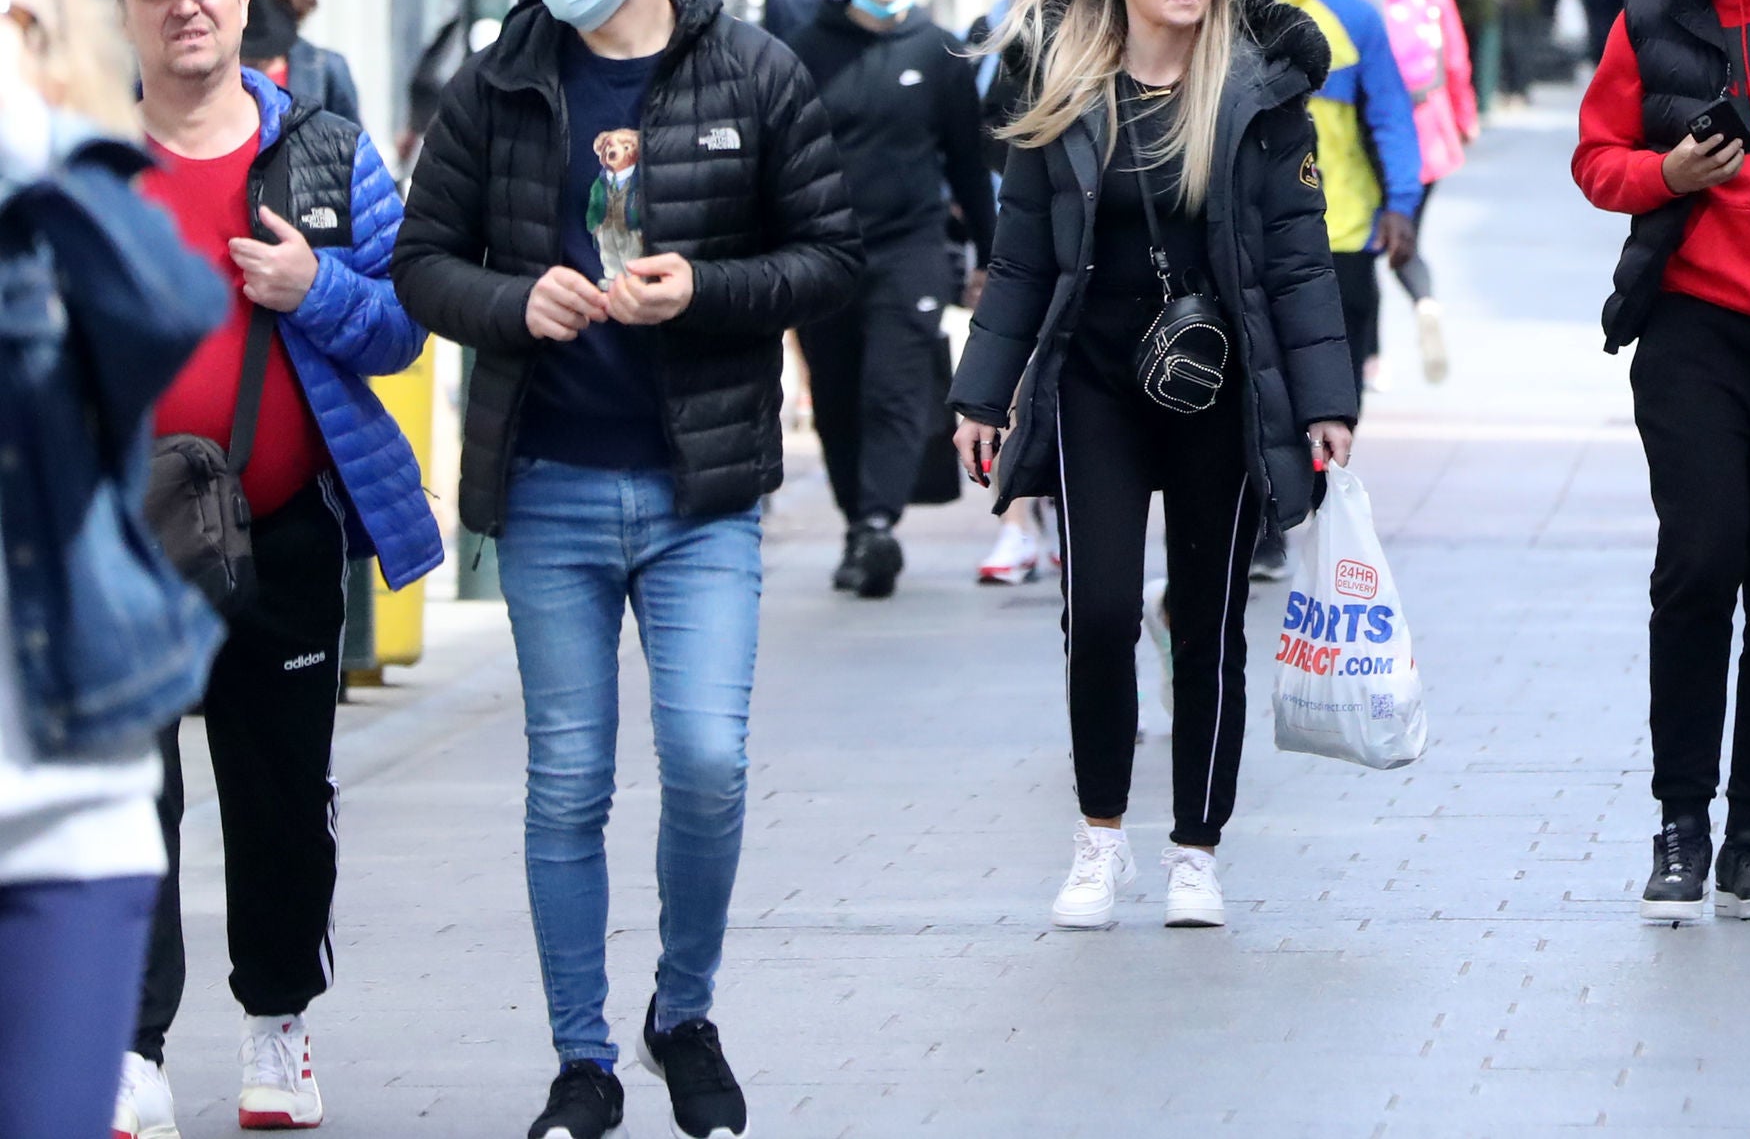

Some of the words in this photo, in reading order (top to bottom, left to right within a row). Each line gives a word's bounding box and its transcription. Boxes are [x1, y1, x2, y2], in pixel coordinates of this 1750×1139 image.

[1340, 565, 1374, 583] 24HR
[1337, 579, 1376, 593] DELIVERY
[284, 651, 326, 670] adidas
